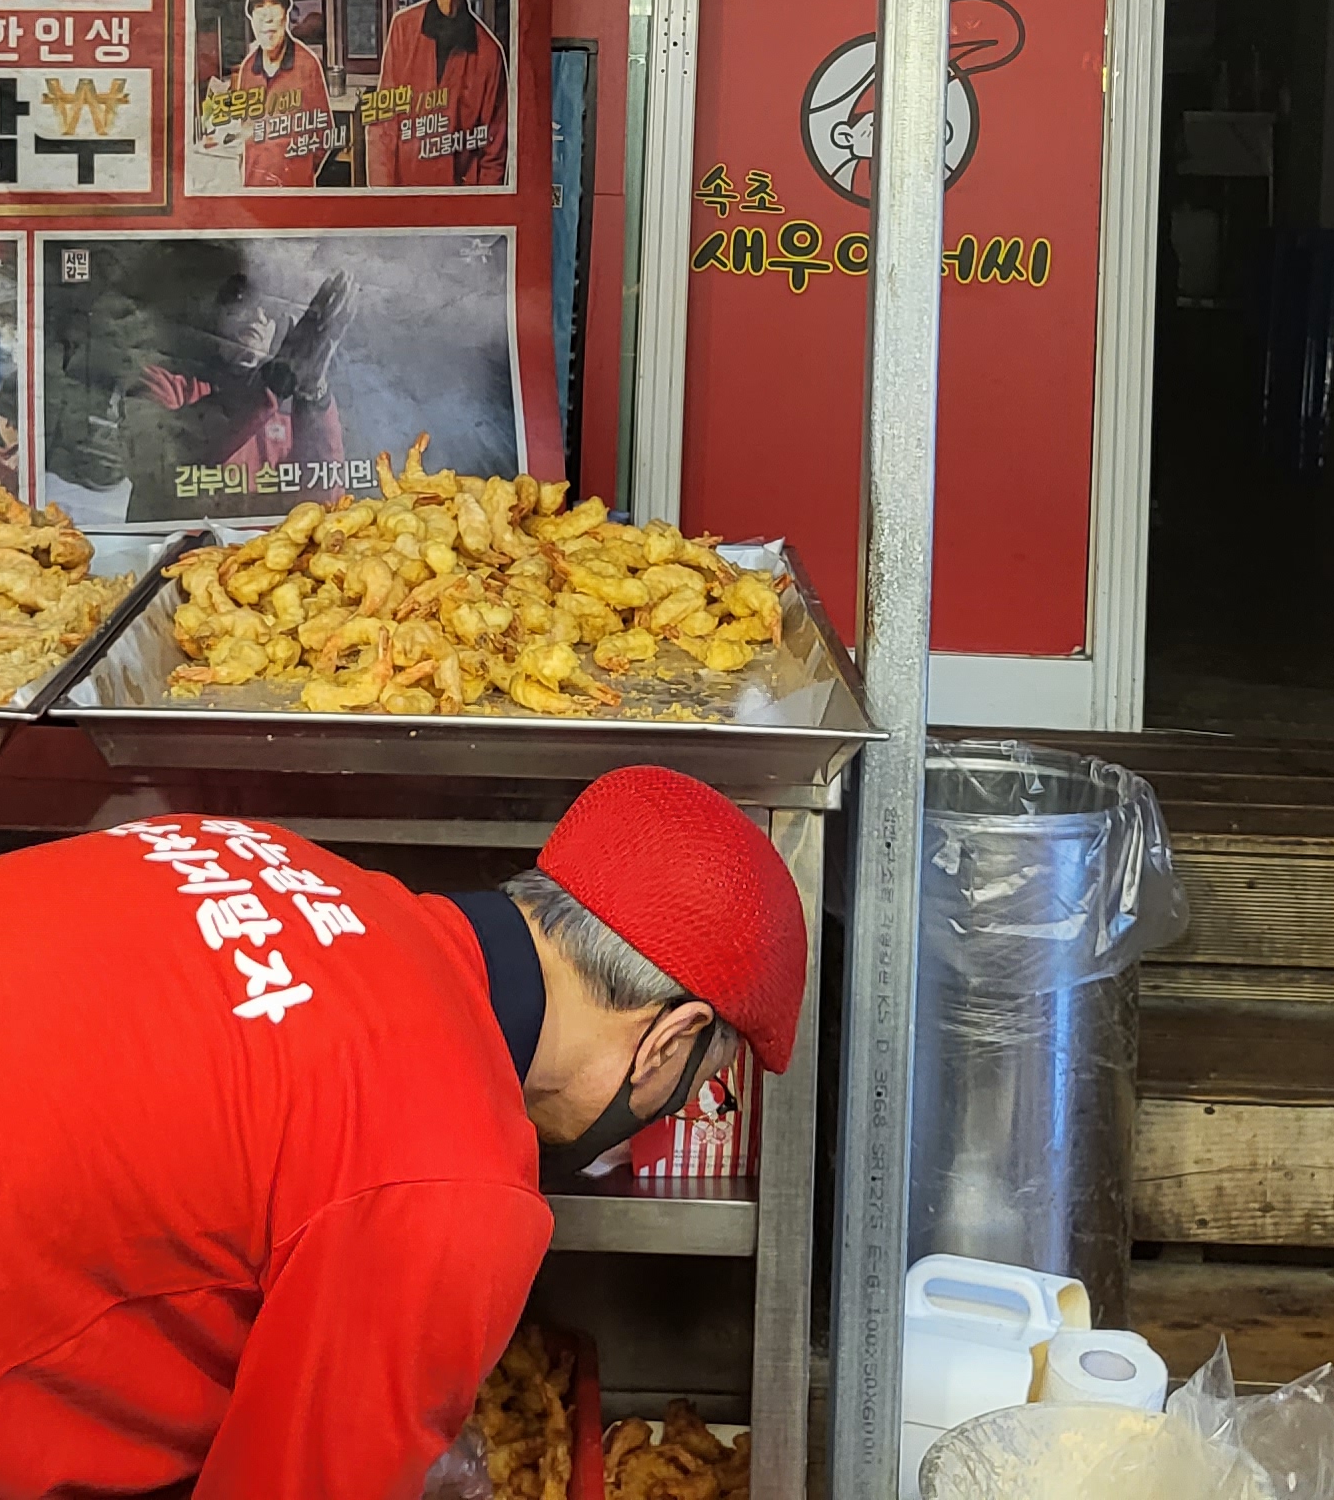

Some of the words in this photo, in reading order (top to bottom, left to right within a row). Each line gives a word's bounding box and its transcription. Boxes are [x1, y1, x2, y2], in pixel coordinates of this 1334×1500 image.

[416, 112, 449, 137] 벌이는
[284, 134, 320, 158] 소방수
[322, 125, 346, 150] 아내
[419, 131, 463, 159] 사고뭉치
[695, 164, 784, 217] 속초
[175, 463, 248, 498] 갑부의
[255, 461, 302, 494] 손만
